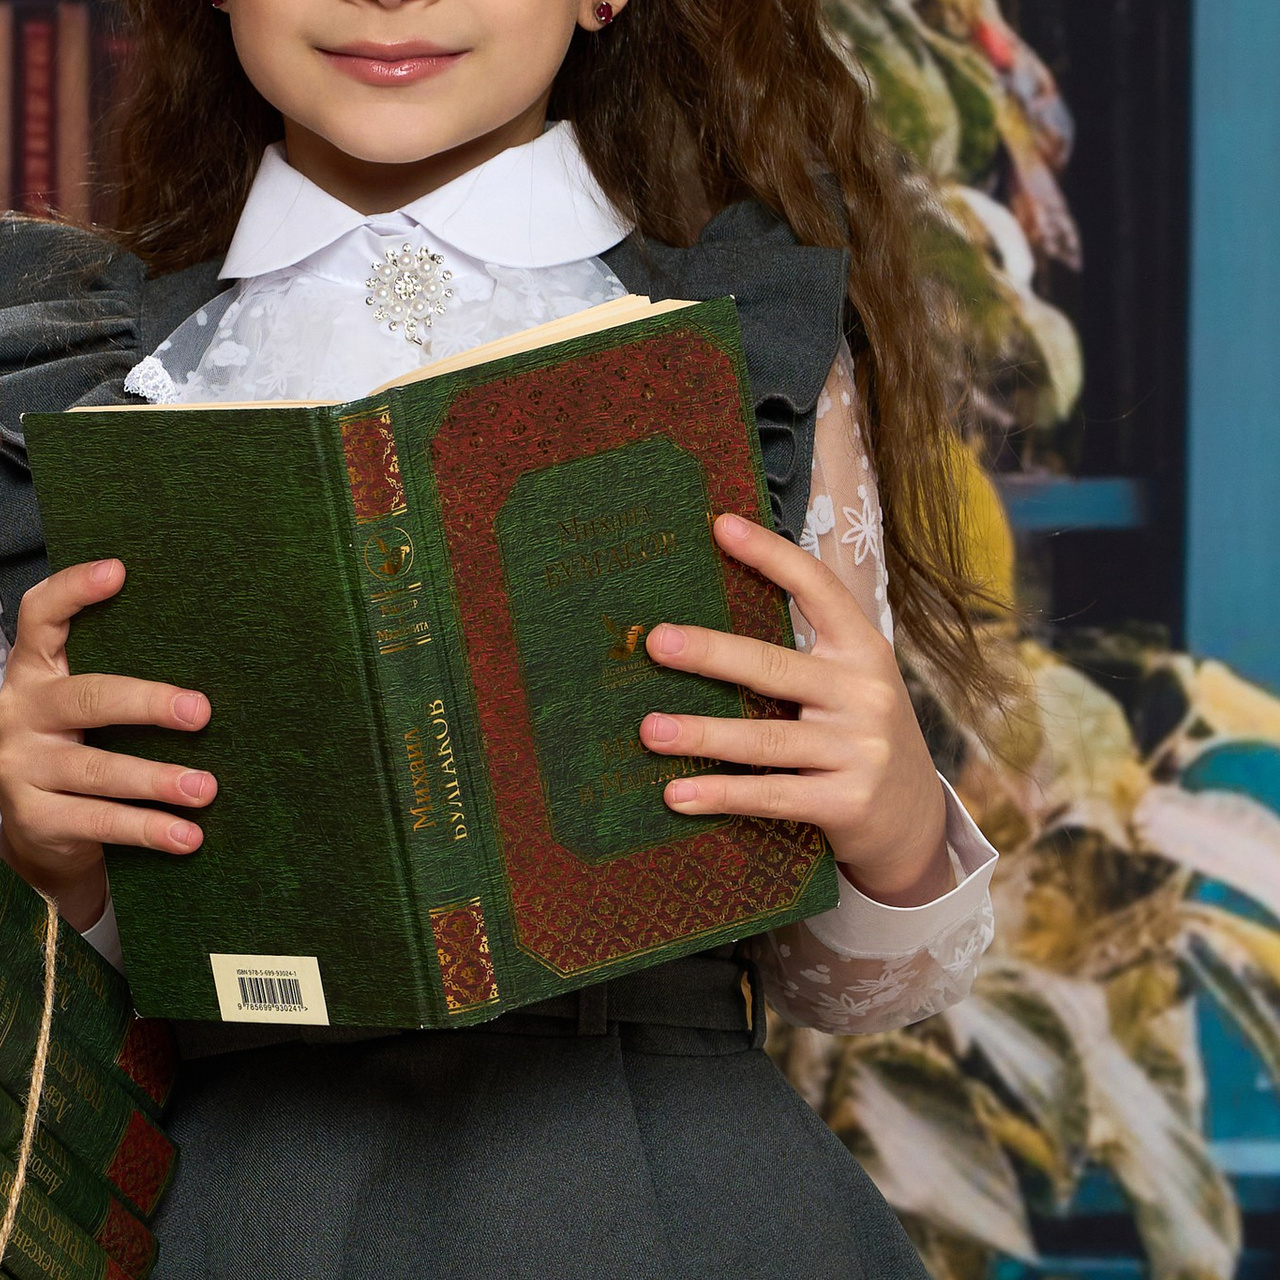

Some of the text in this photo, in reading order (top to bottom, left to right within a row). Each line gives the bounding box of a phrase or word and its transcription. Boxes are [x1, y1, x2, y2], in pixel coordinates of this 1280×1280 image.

[404, 727, 438, 832] Михаил
[426, 699, 469, 840] БУЛГАКОВ
[48, 1040, 105, 1113] ТОЛСТО
[0, 1171, 90, 1269] ГРИБОЕДВ
